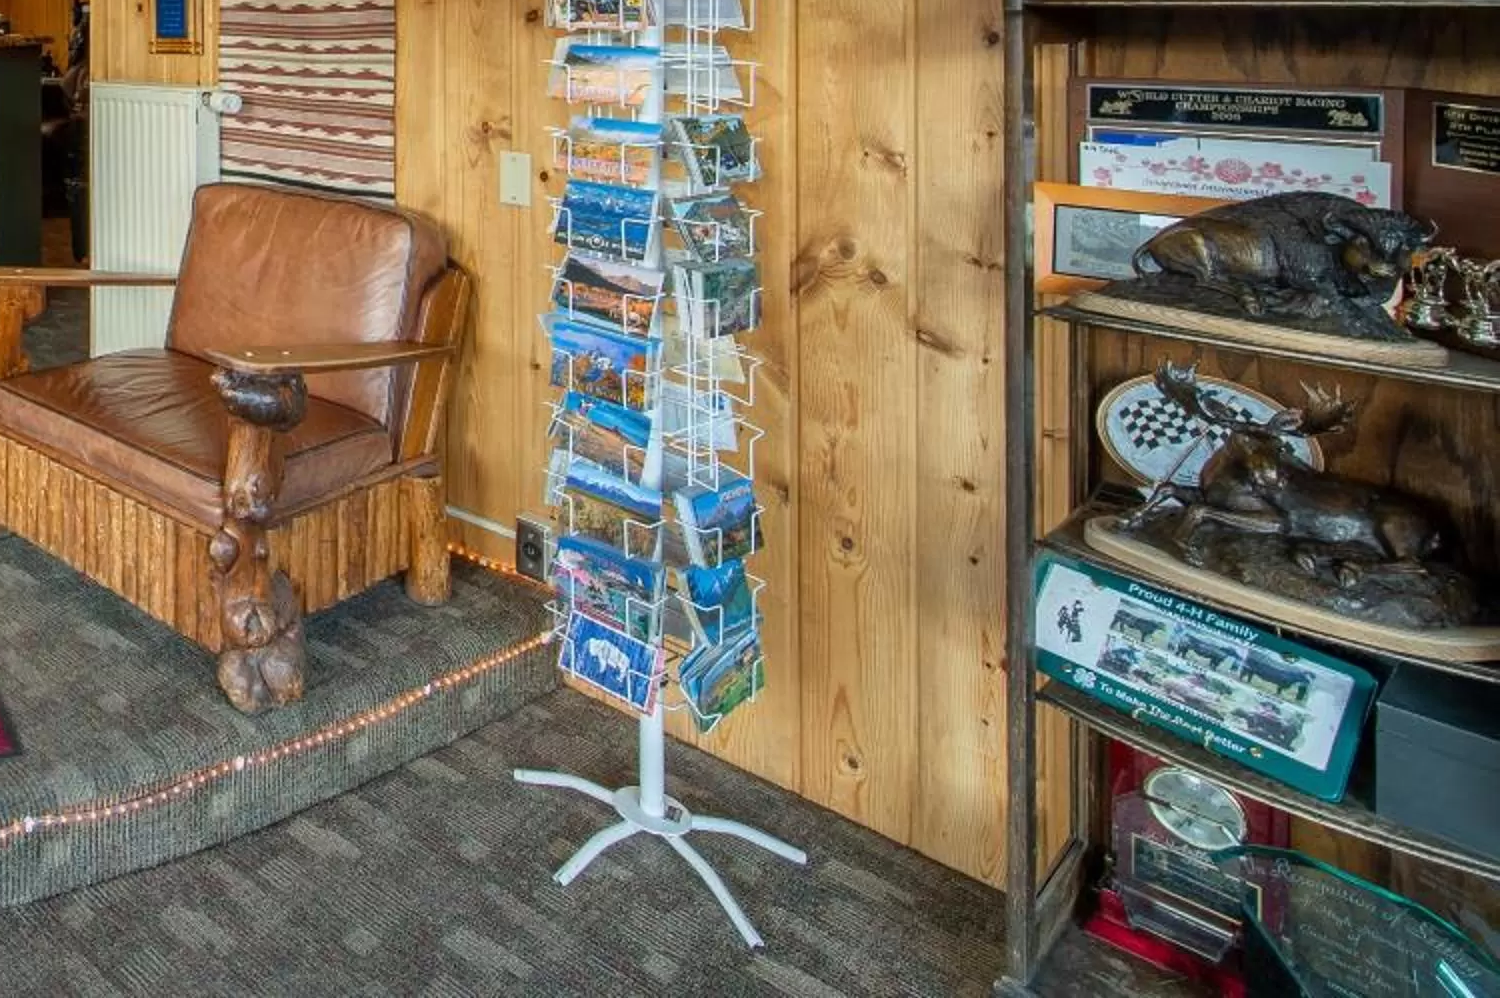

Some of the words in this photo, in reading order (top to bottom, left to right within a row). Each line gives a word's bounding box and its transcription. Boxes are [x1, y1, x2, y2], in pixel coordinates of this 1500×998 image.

[1128, 583, 1173, 607] Proud
[1176, 601, 1203, 619] 4-H
[1205, 613, 1260, 642] Family
